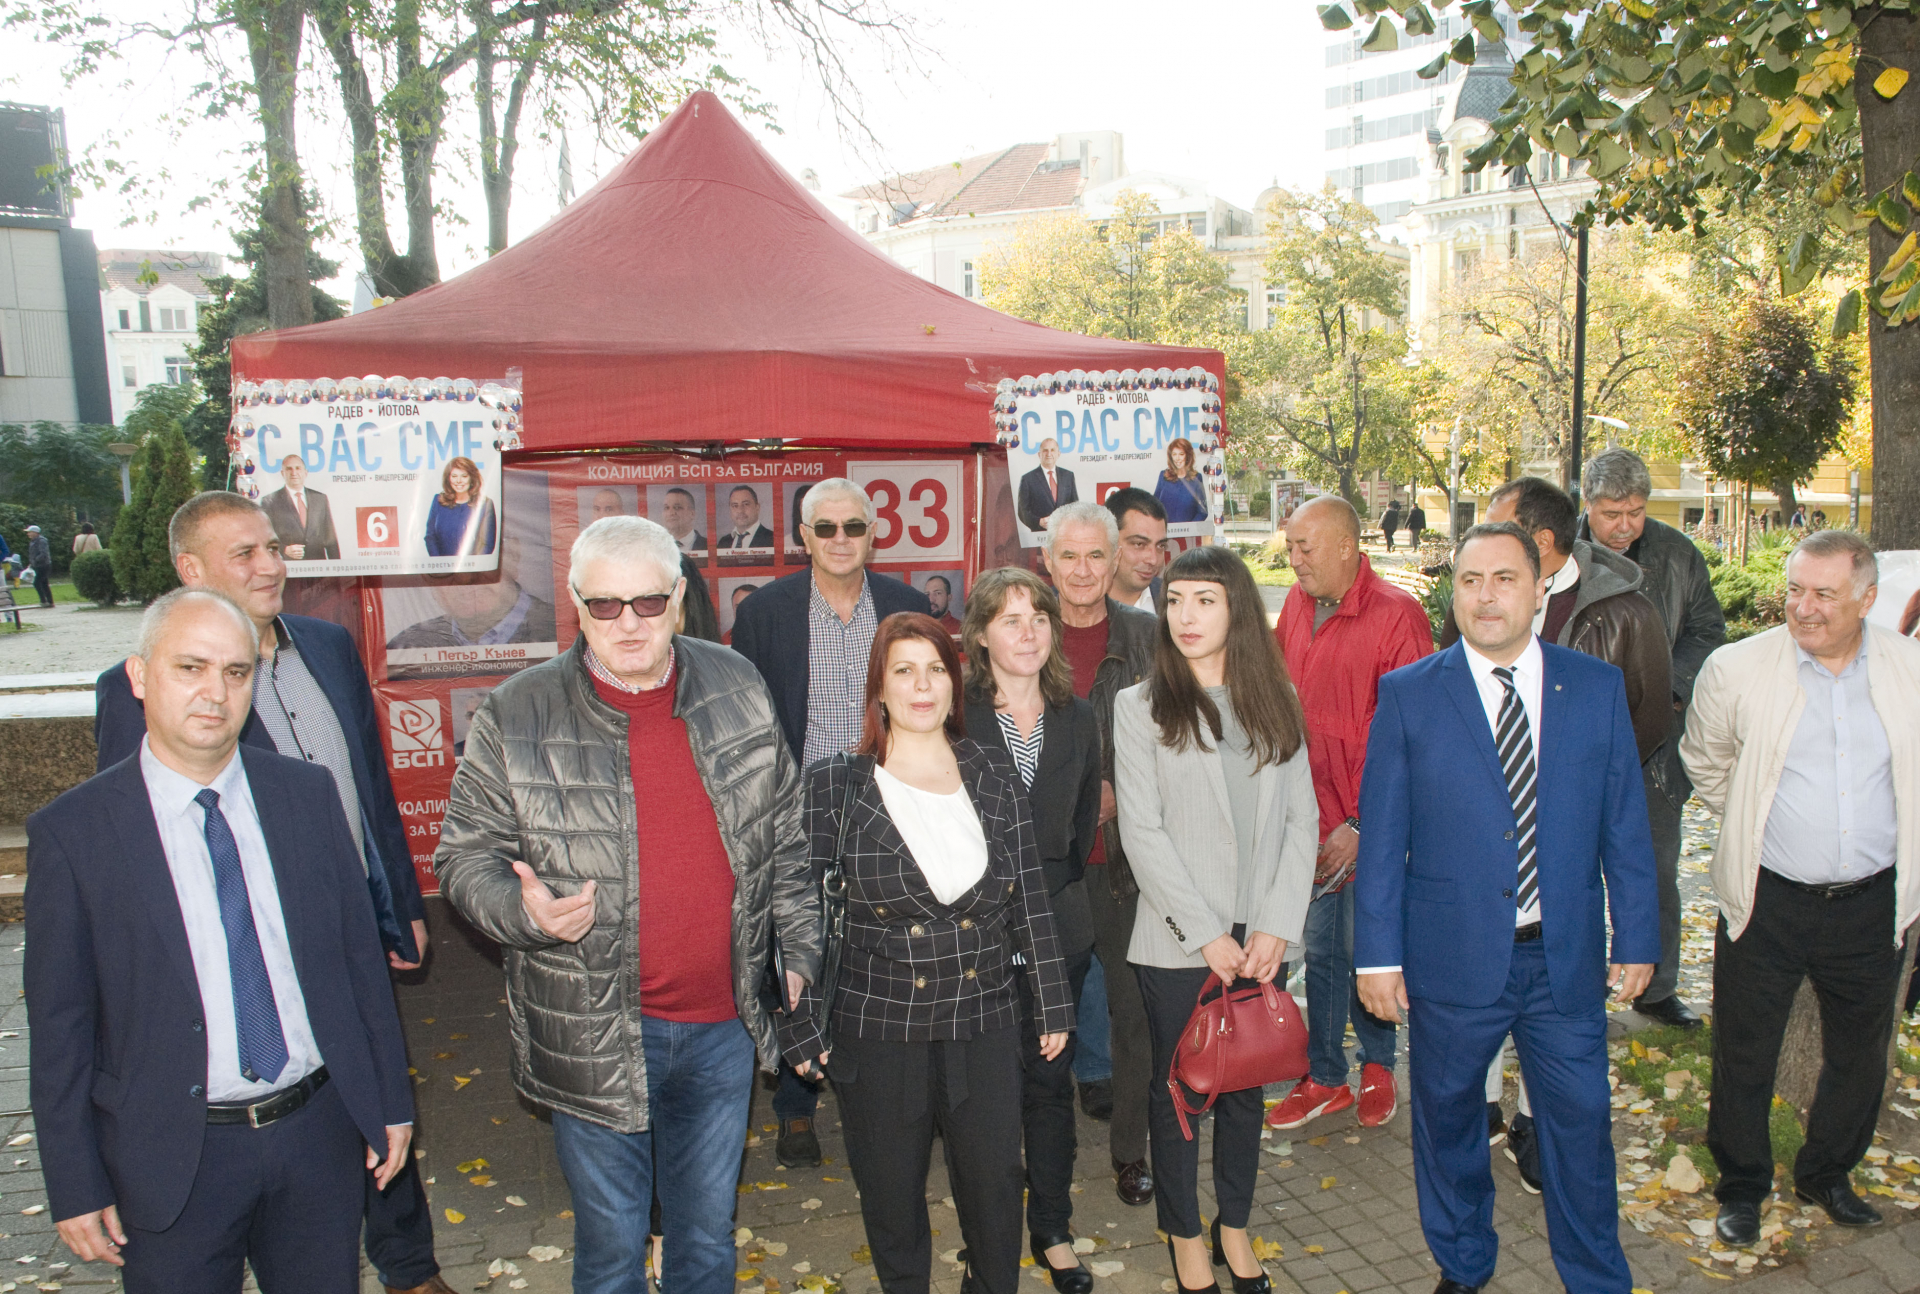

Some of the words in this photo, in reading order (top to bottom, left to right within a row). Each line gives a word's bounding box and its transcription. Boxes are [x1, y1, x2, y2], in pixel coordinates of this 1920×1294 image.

[1077, 394, 1105, 406] РАДЕВ
[328, 406, 363, 419] РАДЕВ
[378, 403, 420, 417] ЙОТОВА
[1021, 411, 1041, 454] С
[1056, 408, 1120, 454] ВАС
[1134, 407, 1199, 450] СМЕ
[258, 424, 282, 474] С
[300, 422, 382, 473] ВАС
[400, 420, 484, 470] СМЕ
[1114, 452, 1152, 461] ВИЦЕПРЕЗИДЕНТ
[332, 474, 366, 482] ПРЕЗИДЕНТ
[374, 473, 419, 482] ВИЦЕПРЕЗИДЕ
[588, 464, 675, 480] КОАЛИЦИЯ
[679, 464, 712, 479] БСП
[716, 465, 736, 478] ЗА
[740, 462, 824, 478] БЪЛГАРИЯ
[862, 478, 950, 550] 33
[366, 512, 389, 542] 6
[423, 653, 432, 661] 1.
[438, 650, 478, 661] Петър
[485, 648, 526, 659] Кънев
[421, 661, 528, 673] инженер-икономист
[392, 750, 445, 769] БСП
[409, 825, 427, 836] ЗА
[422, 866, 432, 874] 14
